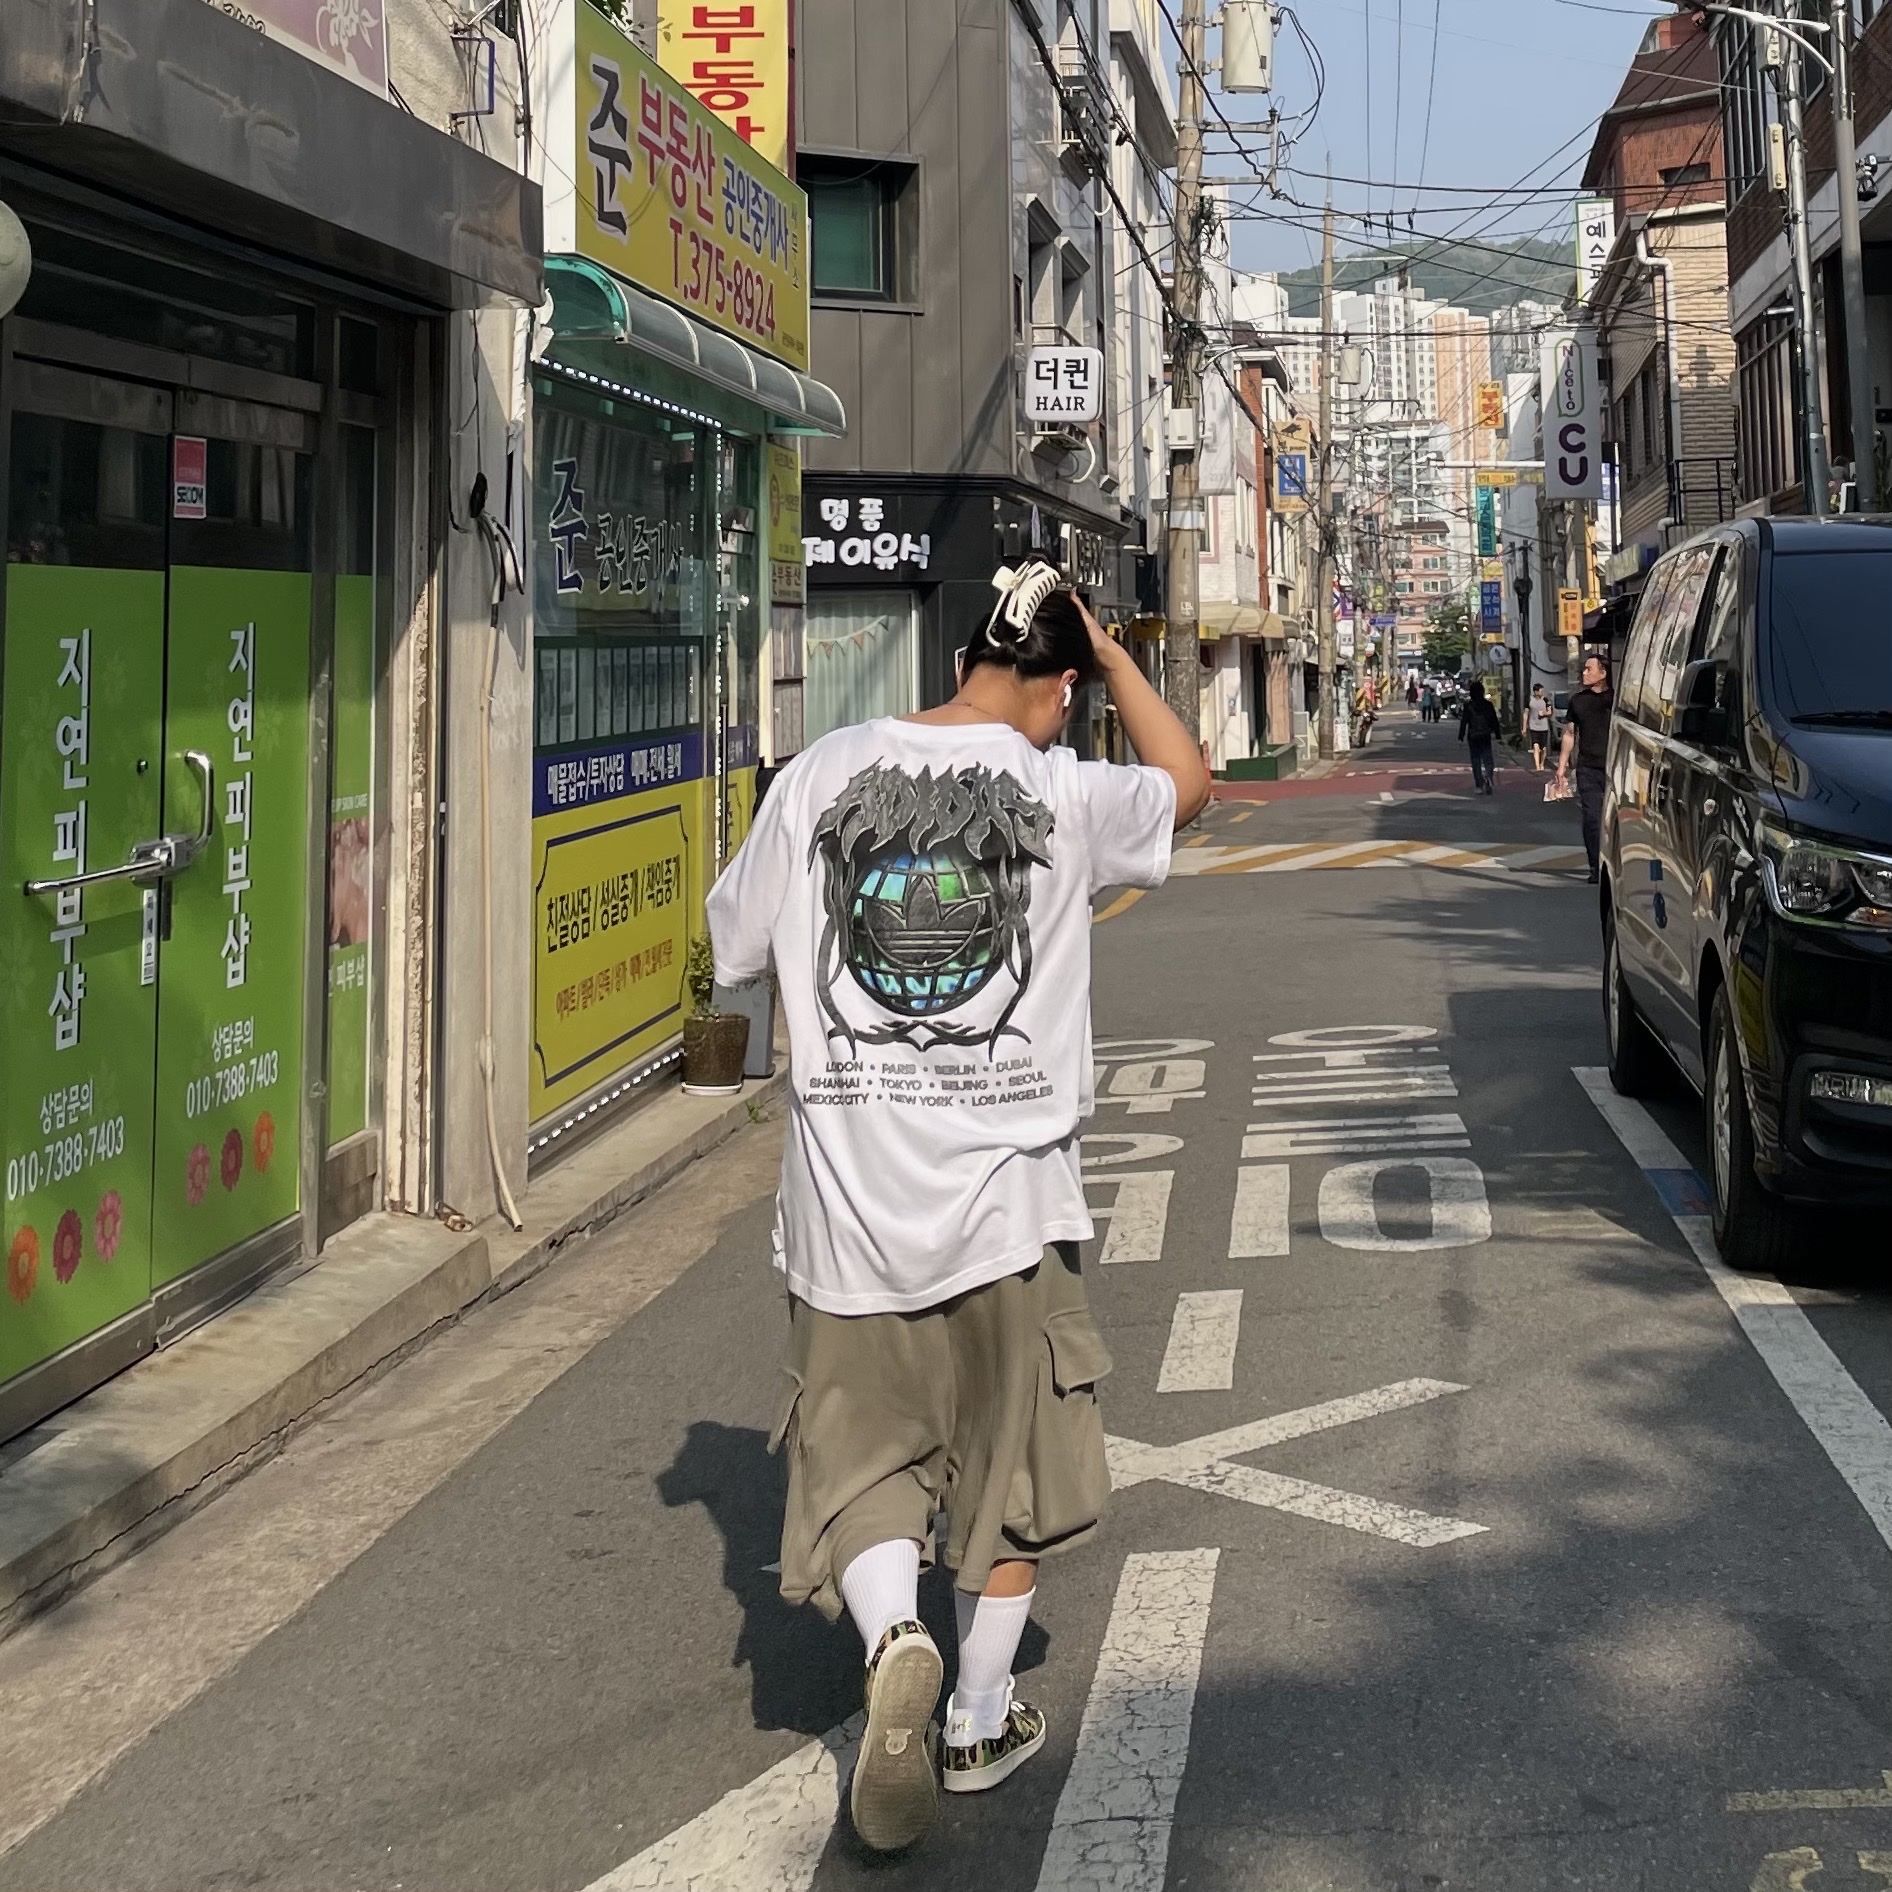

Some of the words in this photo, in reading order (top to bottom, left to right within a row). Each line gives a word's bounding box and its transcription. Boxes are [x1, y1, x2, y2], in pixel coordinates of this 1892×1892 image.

[588, 63, 632, 235] 준
[638, 78, 716, 224] 부동산
[722, 157, 789, 271] 공인중개사
[1034, 358, 1089, 390] 더퀸
[1035, 397, 1085, 411] HAIR
[1559, 423, 1588, 486] CU
[550, 457, 589, 594] 준
[220, 622, 255, 989] 지연피부샵
[48, 628, 90, 1051] 지연피부샵
[336, 954, 366, 992] 피부샵
[211, 1016, 254, 1063] 상담문의
[880, 1078, 922, 1090] TOKYO
[941, 1080, 988, 1091] BEIJING
[1008, 1070, 1047, 1087] SEOUL
[882, 1063, 916, 1075] PARIS
[934, 1064, 975, 1075] BERLIN
[996, 1056, 1032, 1073] DUBAI
[40, 1078, 93, 1134] 상담문의
[890, 1093, 916, 1105] NEW
[918, 1096, 954, 1108] YORK
[971, 1094, 996, 1107] LOS
[998, 1084, 1054, 1104] ANGELES
